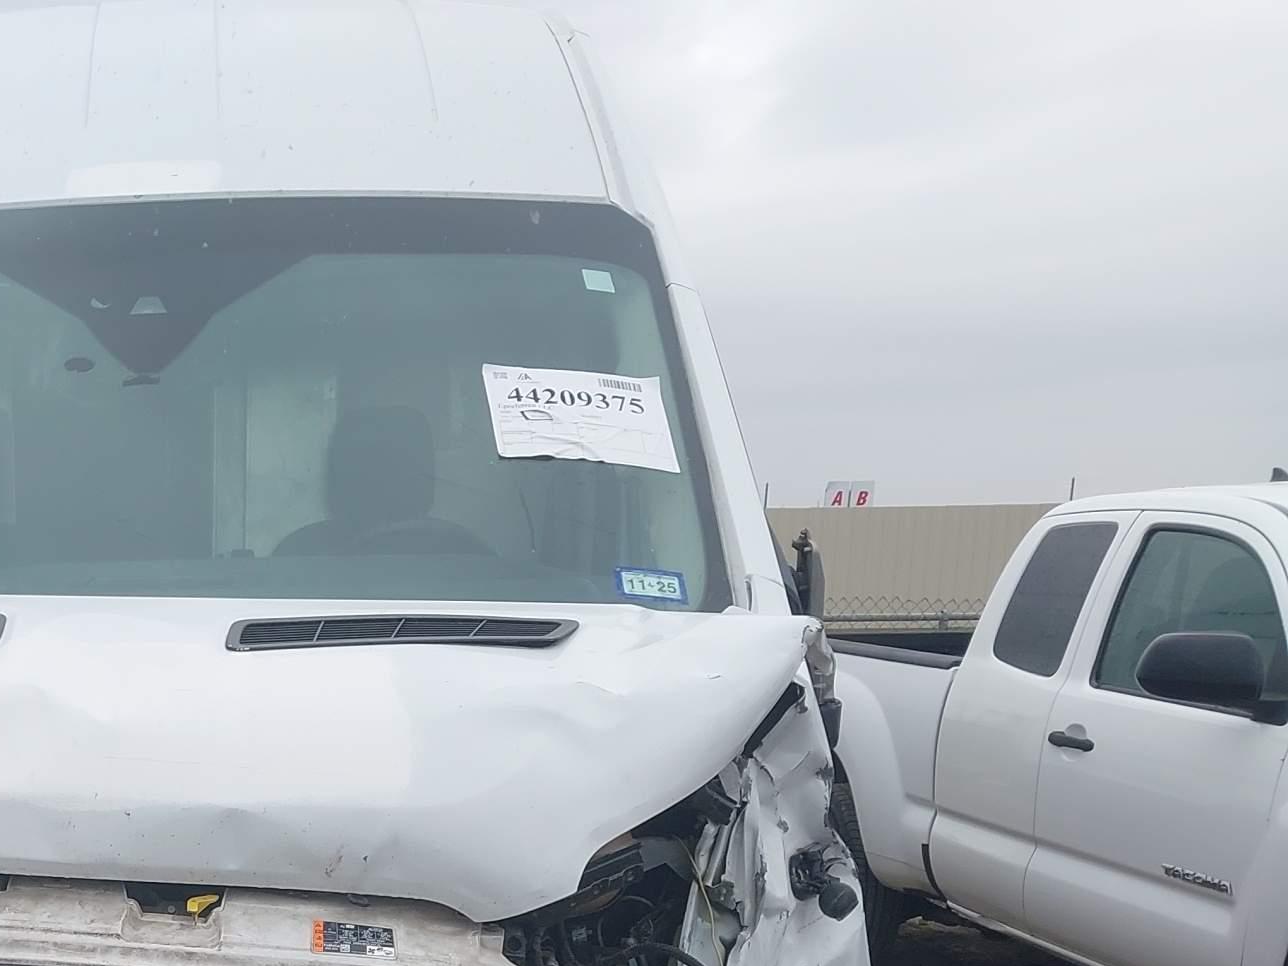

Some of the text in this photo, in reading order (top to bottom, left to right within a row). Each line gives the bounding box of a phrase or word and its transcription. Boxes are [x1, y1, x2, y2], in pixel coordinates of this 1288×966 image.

[507, 386, 645, 415] 44209375
[831, 491, 843, 506] A
[856, 491, 869, 506] B
